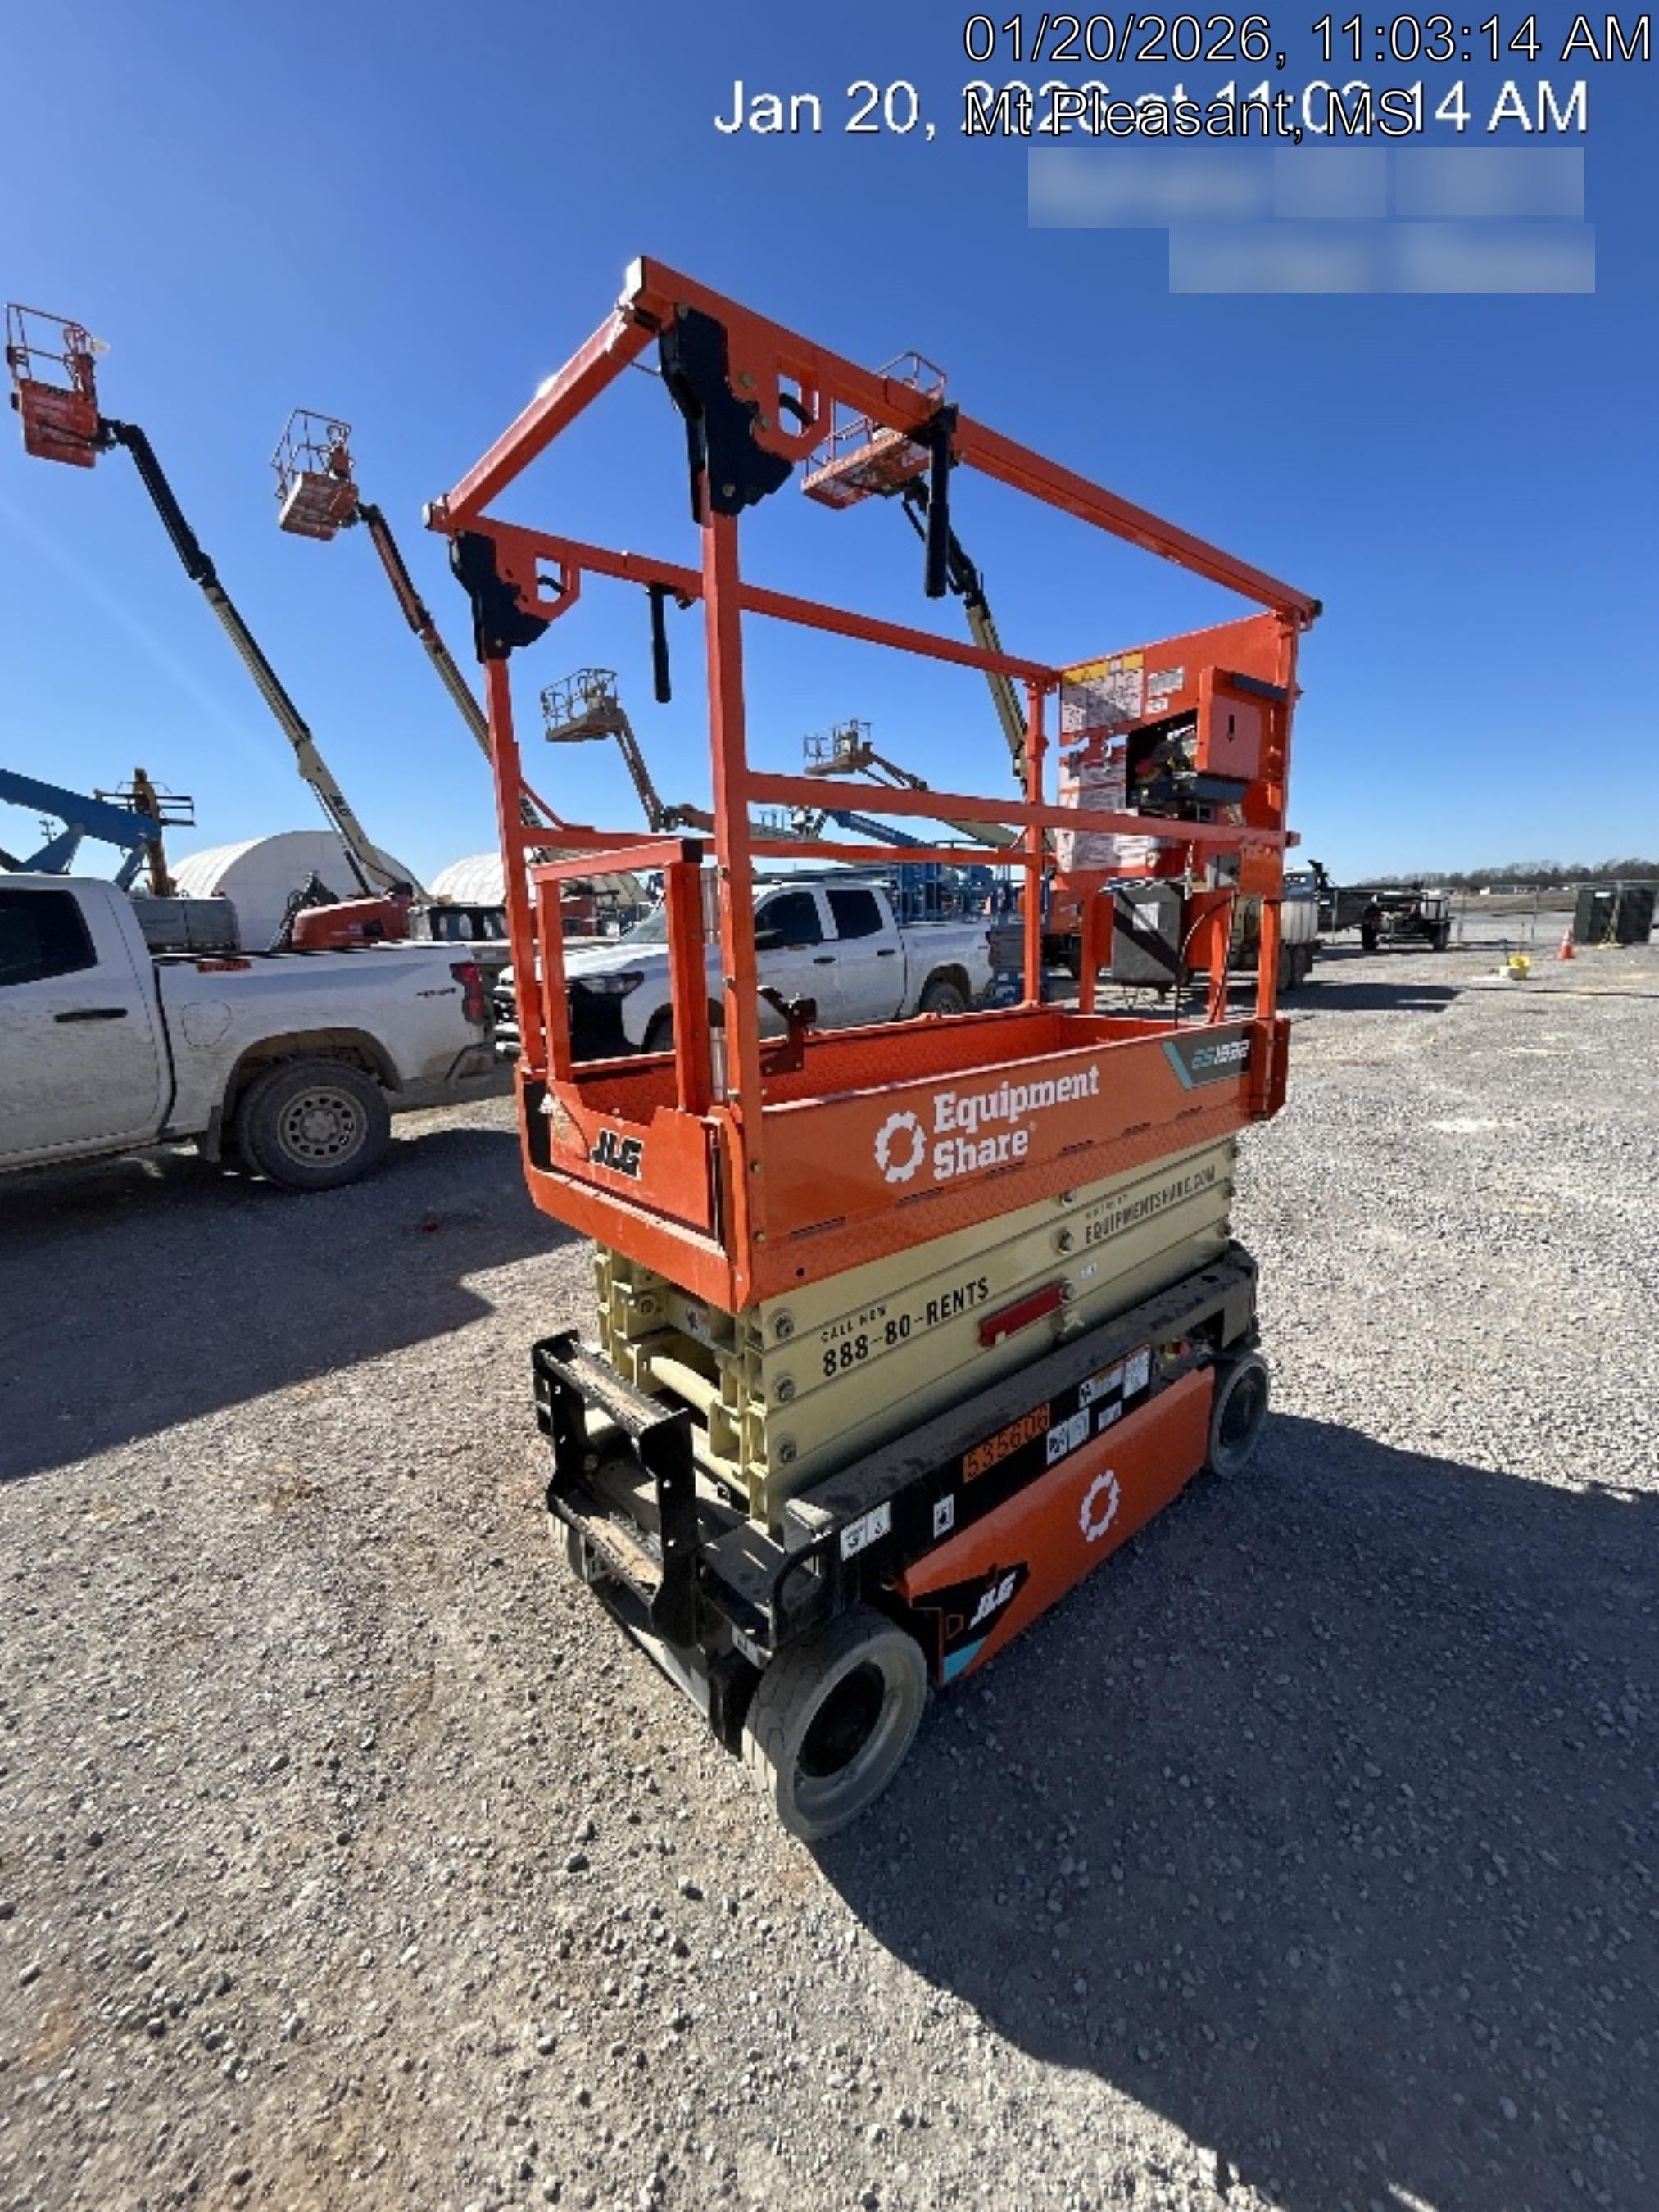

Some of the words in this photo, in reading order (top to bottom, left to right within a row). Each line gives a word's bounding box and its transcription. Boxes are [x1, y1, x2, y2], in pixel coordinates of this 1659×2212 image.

[933, 1064, 1099, 1133] Equipment
[590, 1127, 644, 1181] JLG
[933, 1127, 1029, 1181] Share
[821, 1320, 854, 1343] CALL
[823, 1276, 990, 1376] 888-80-RENTS
[968, 1571, 1018, 1630] JLG
